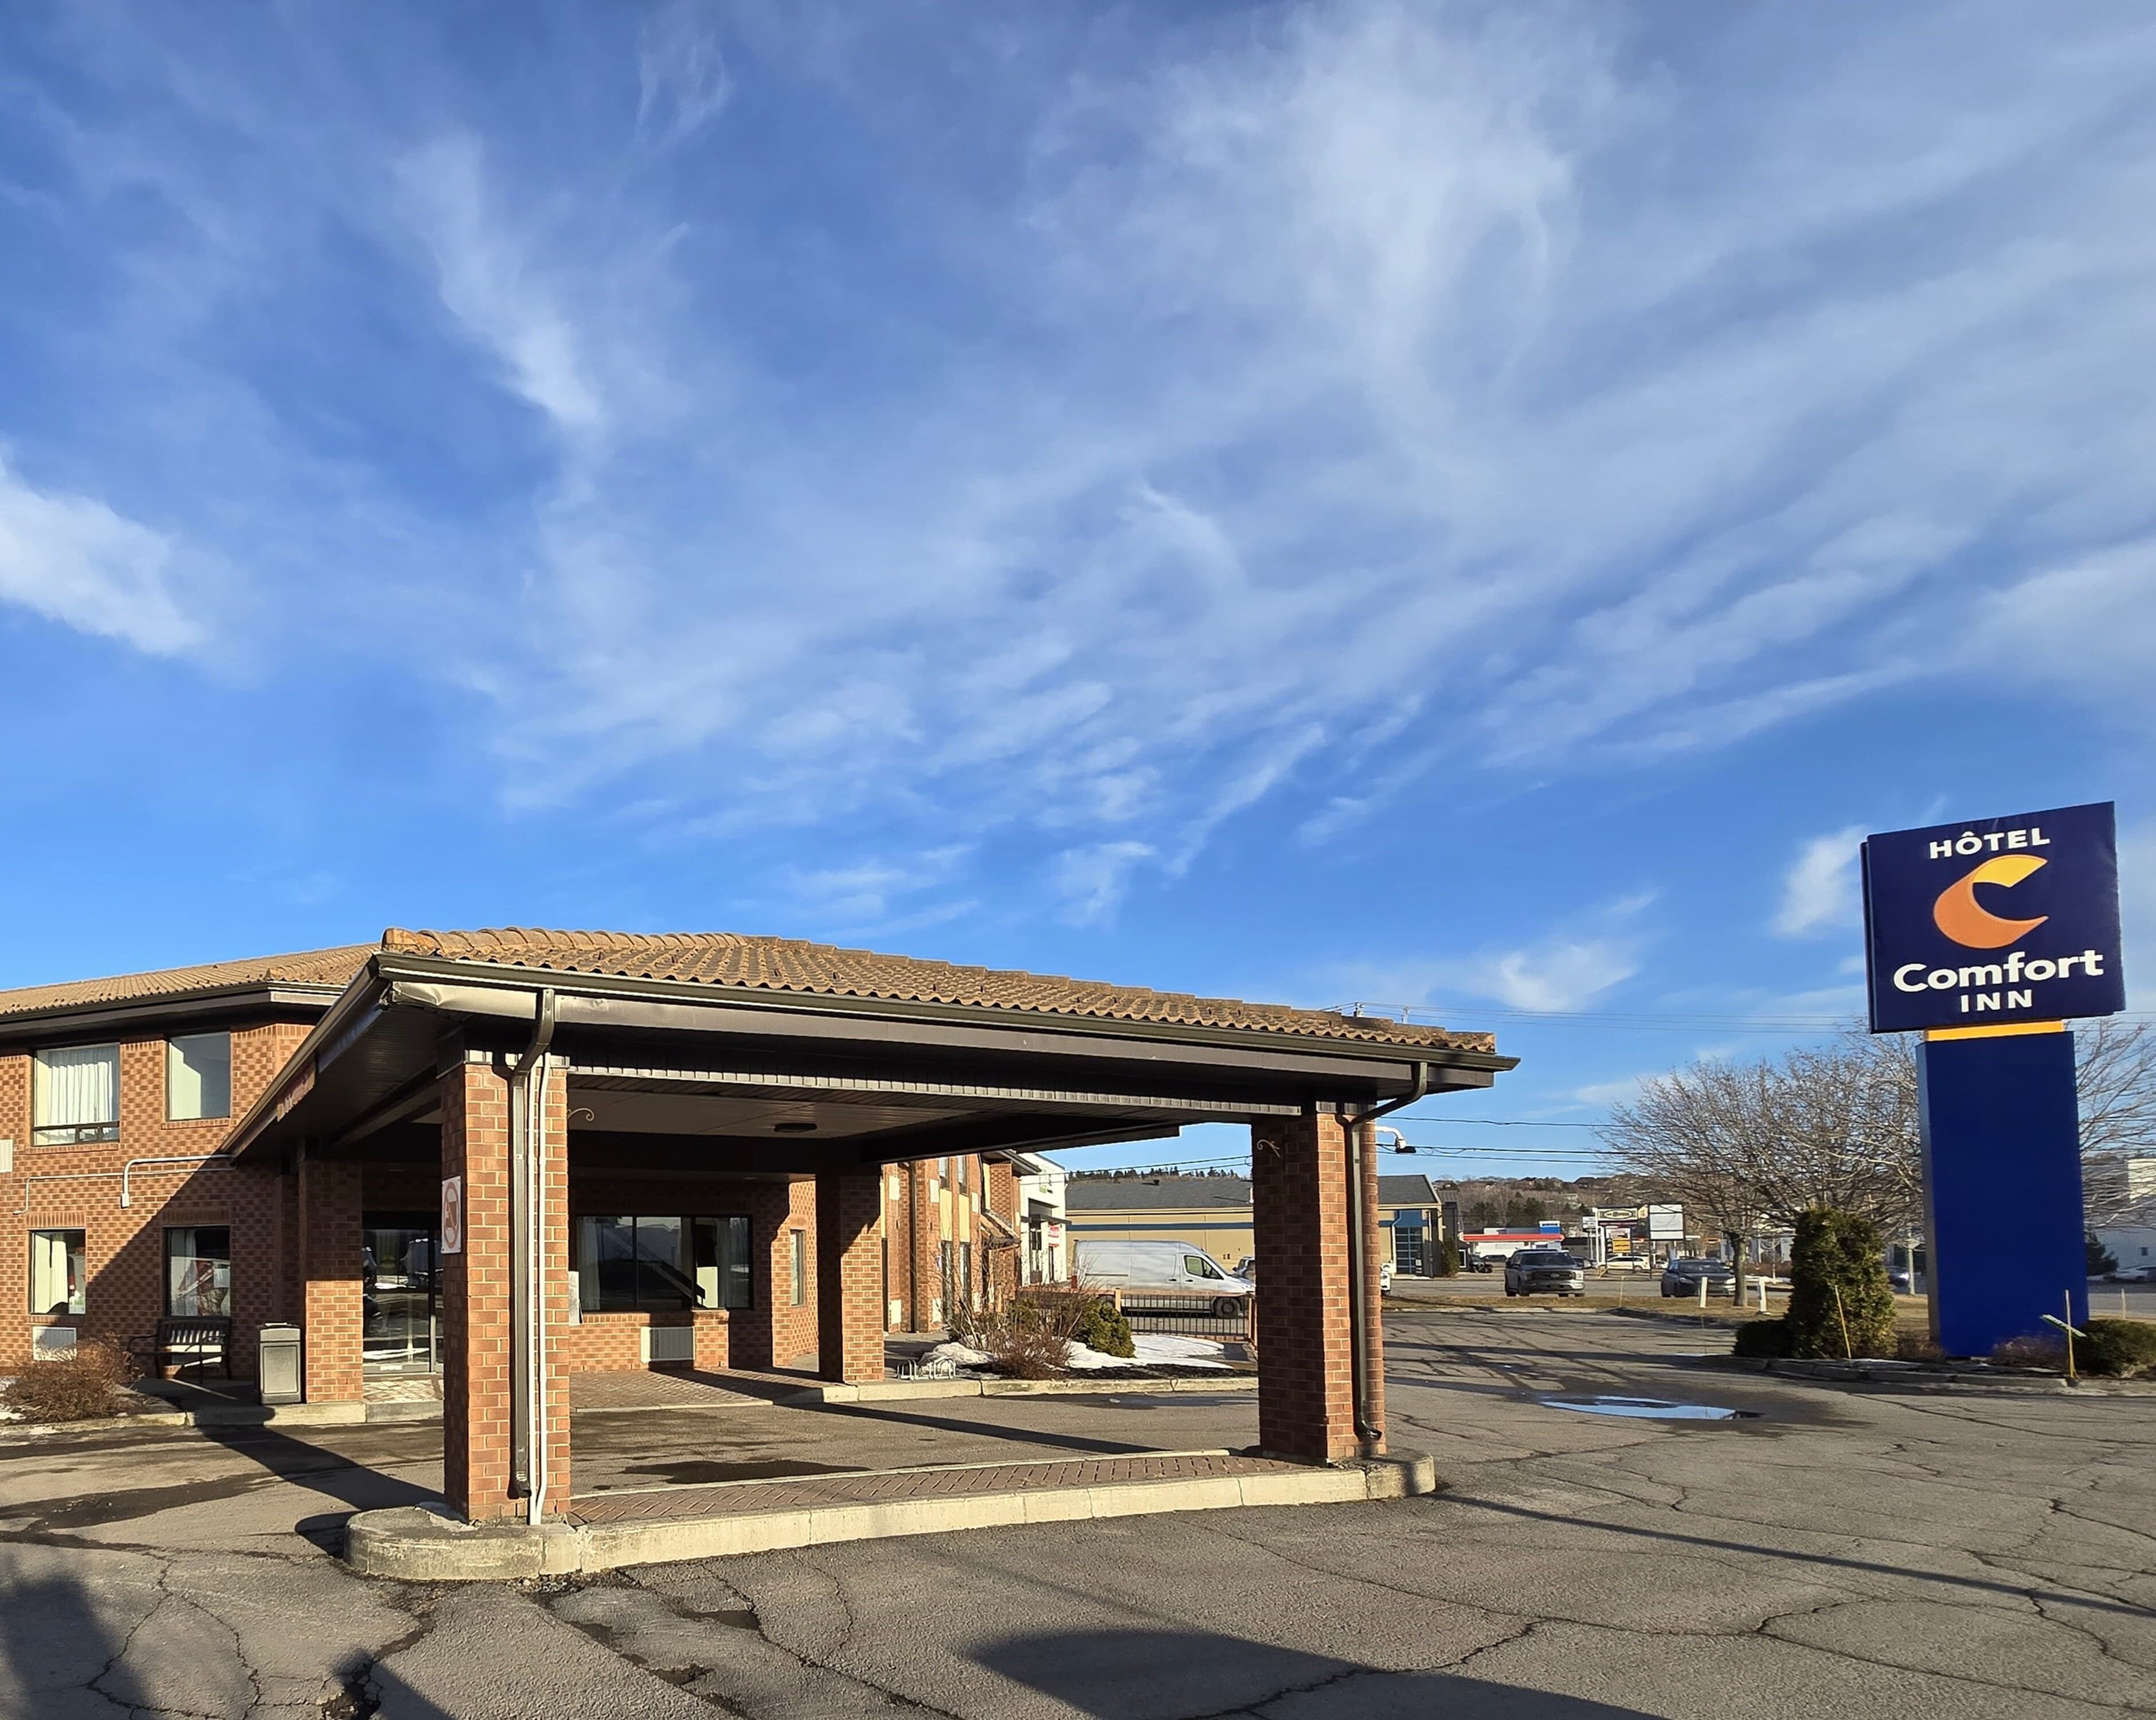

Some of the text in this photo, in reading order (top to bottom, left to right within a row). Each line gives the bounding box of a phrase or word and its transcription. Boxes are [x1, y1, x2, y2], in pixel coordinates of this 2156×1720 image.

[1929, 827, 2051, 859] HÔTEL
[1893, 949, 2104, 992] Comfort
[1960, 989, 2032, 1013] INN
